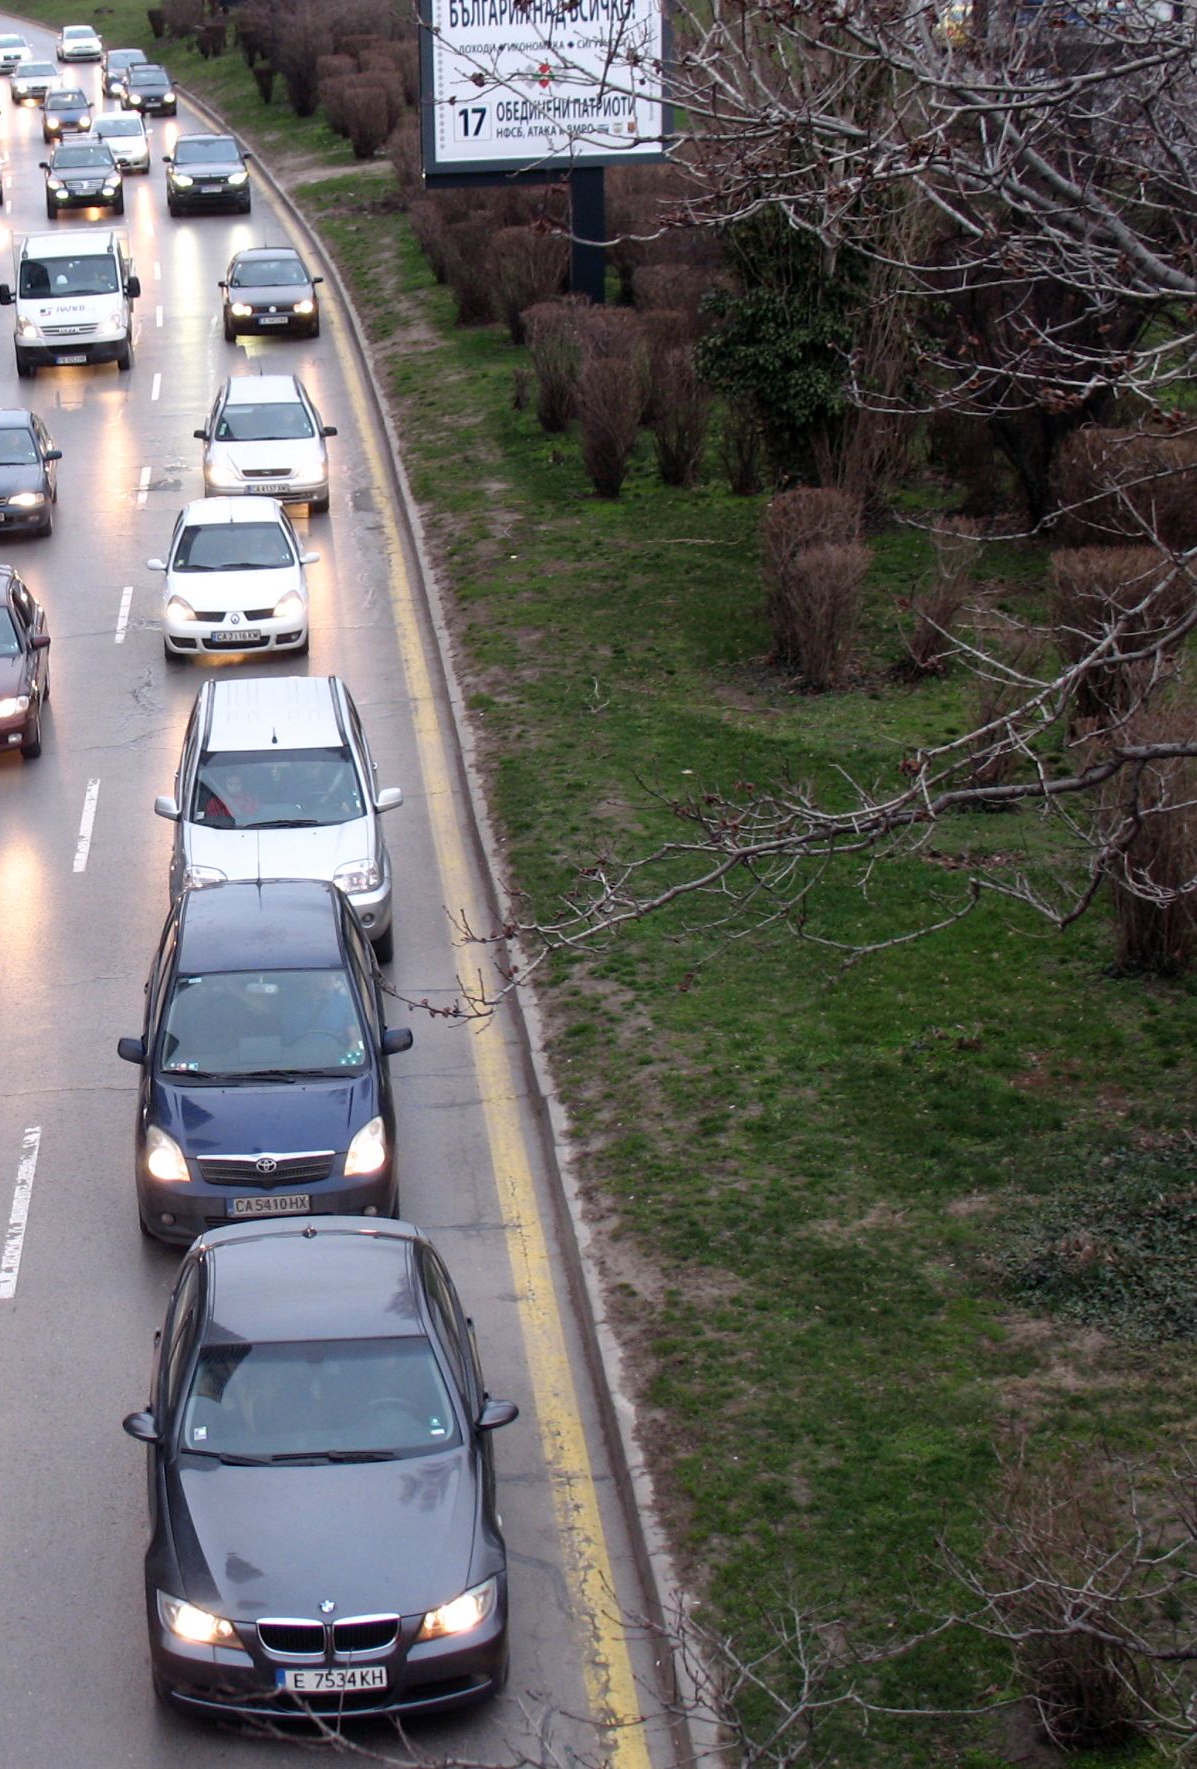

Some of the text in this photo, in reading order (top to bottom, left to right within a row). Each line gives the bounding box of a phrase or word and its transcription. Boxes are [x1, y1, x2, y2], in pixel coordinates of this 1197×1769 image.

[507, 40, 564, 52] ИКОНОМКА
[573, 96, 635, 118] ПАТРИОТИ
[458, 107, 487, 137] 17
[527, 126, 556, 137] АТАКА
[235, 1196, 307, 1213] CA 5410 HX
[293, 1669, 383, 1689] E 7534 KH
